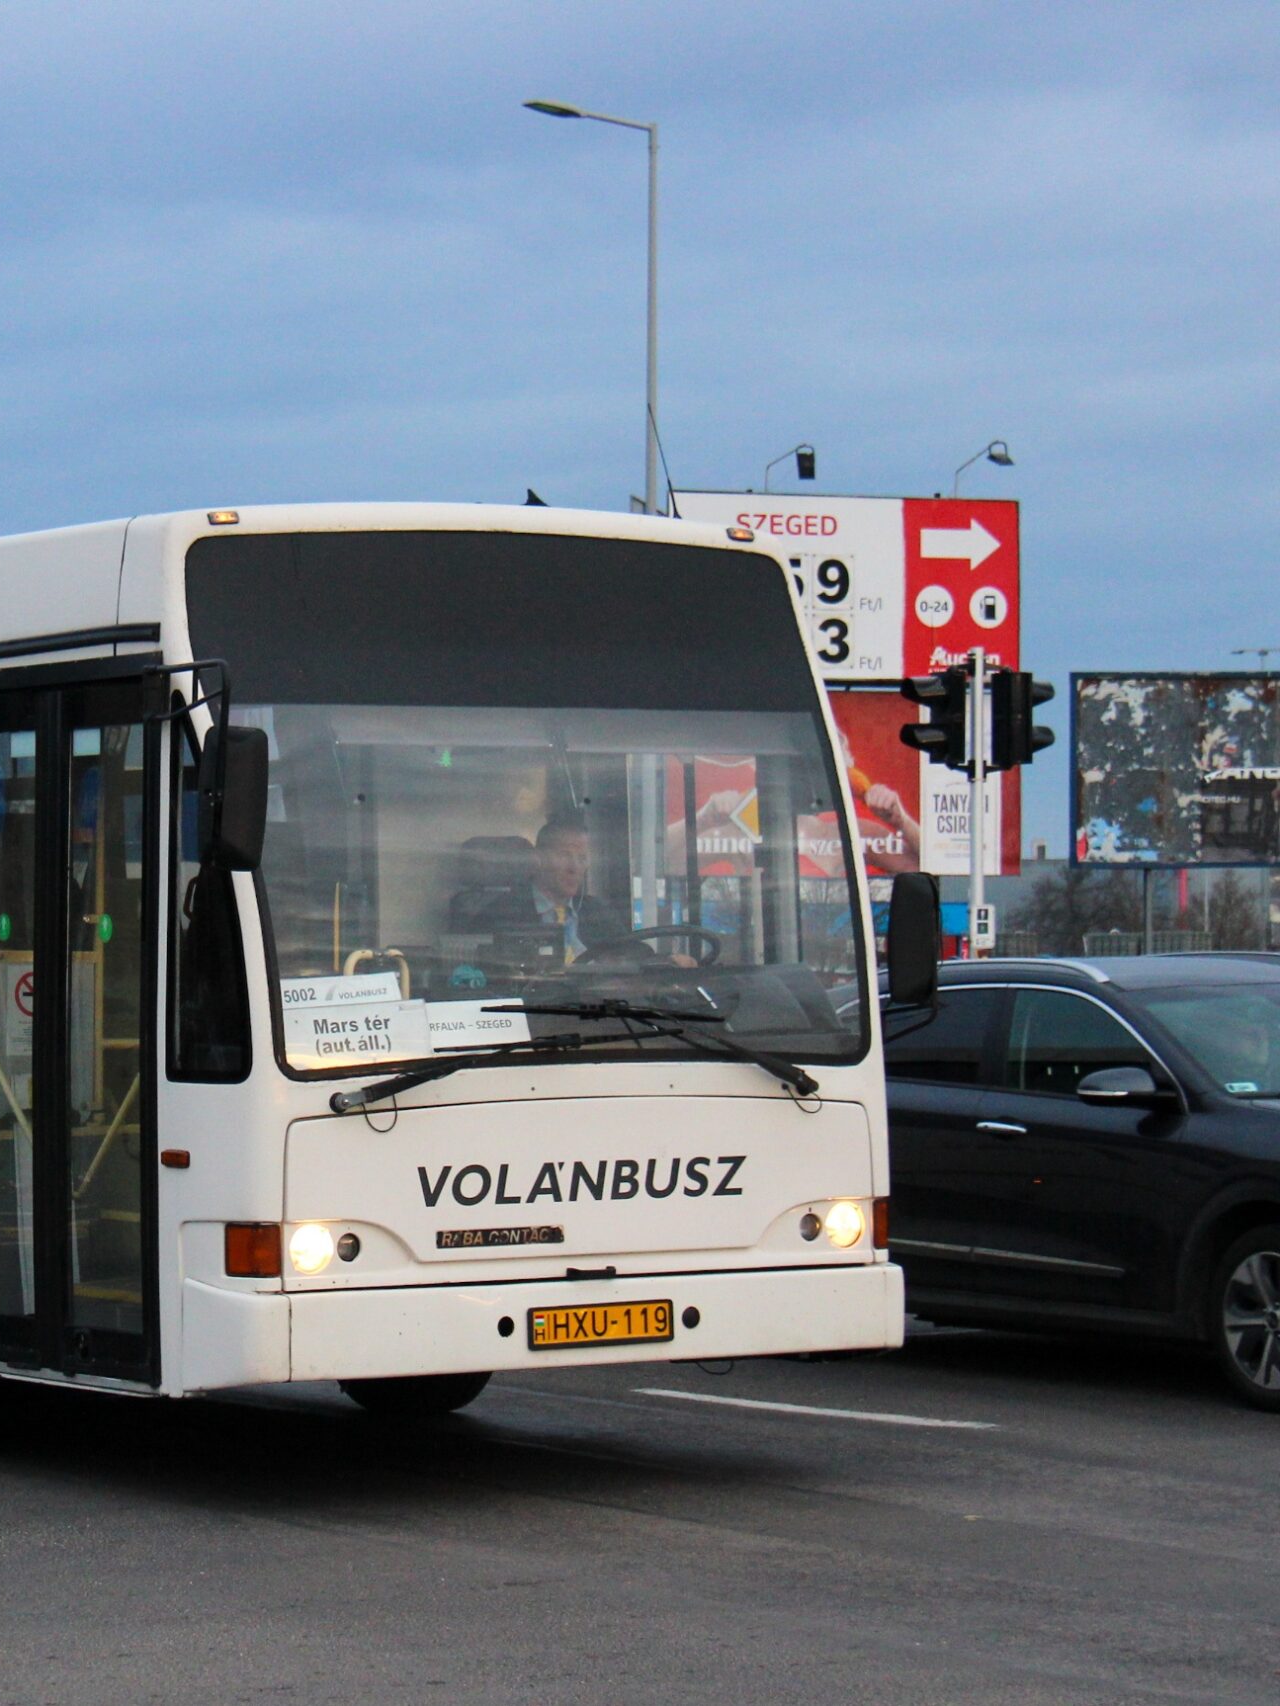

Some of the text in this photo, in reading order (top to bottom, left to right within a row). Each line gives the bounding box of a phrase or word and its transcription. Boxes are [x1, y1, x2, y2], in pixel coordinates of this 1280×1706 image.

[920, 601, 948, 612] 0-24
[284, 988, 317, 1003] 5002
[313, 1014, 390, 1035] Mars tér
[429, 1022, 466, 1031] RFALVA
[476, 1019, 512, 1029] SZEGED
[417, 1155, 747, 1207] VOLÁNBUSZ
[553, 1306, 668, 1340] HXU-119
